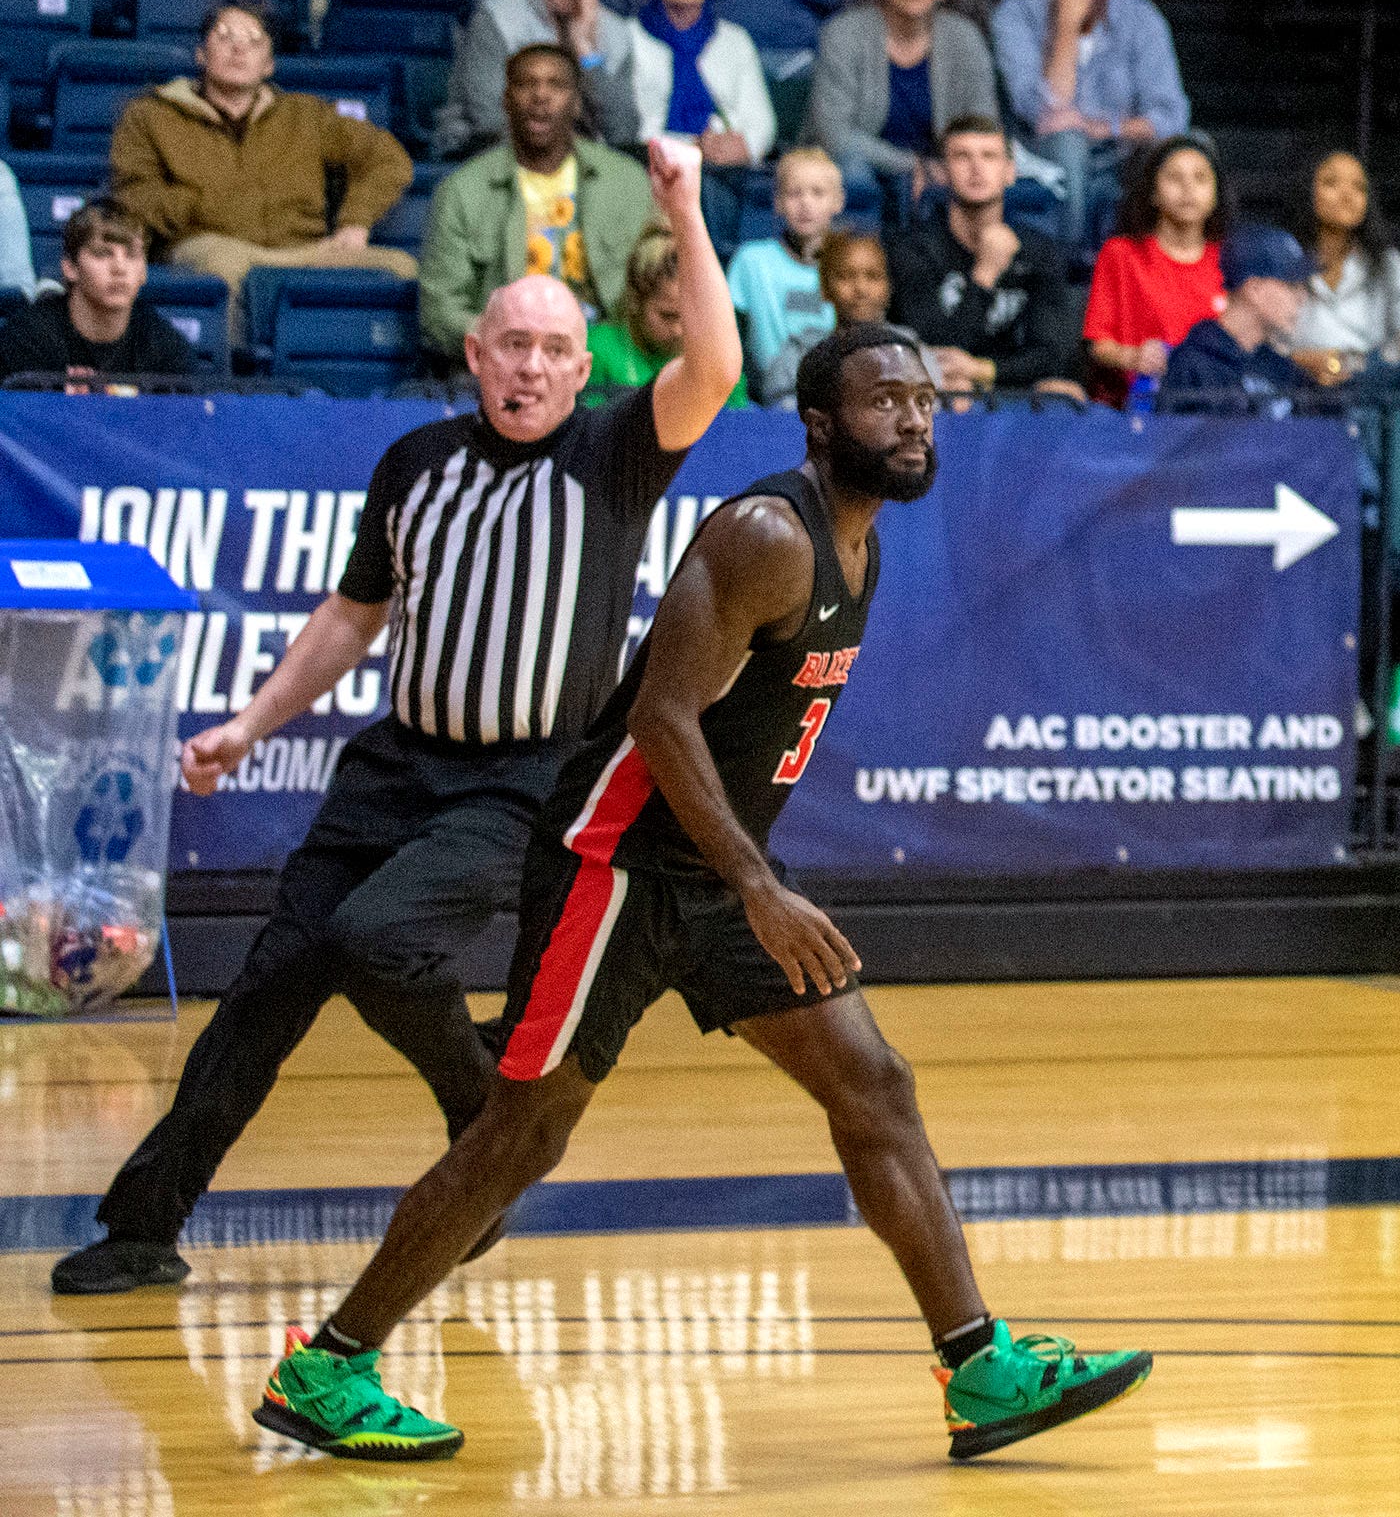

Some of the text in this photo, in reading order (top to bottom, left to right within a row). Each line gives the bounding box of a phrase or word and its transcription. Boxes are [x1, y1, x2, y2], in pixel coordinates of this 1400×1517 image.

[772, 697, 831, 784] 3
[985, 714, 1344, 751] AAC BOOSTER AND
[855, 766, 1342, 803] UWF SPECTATOR SEATING
